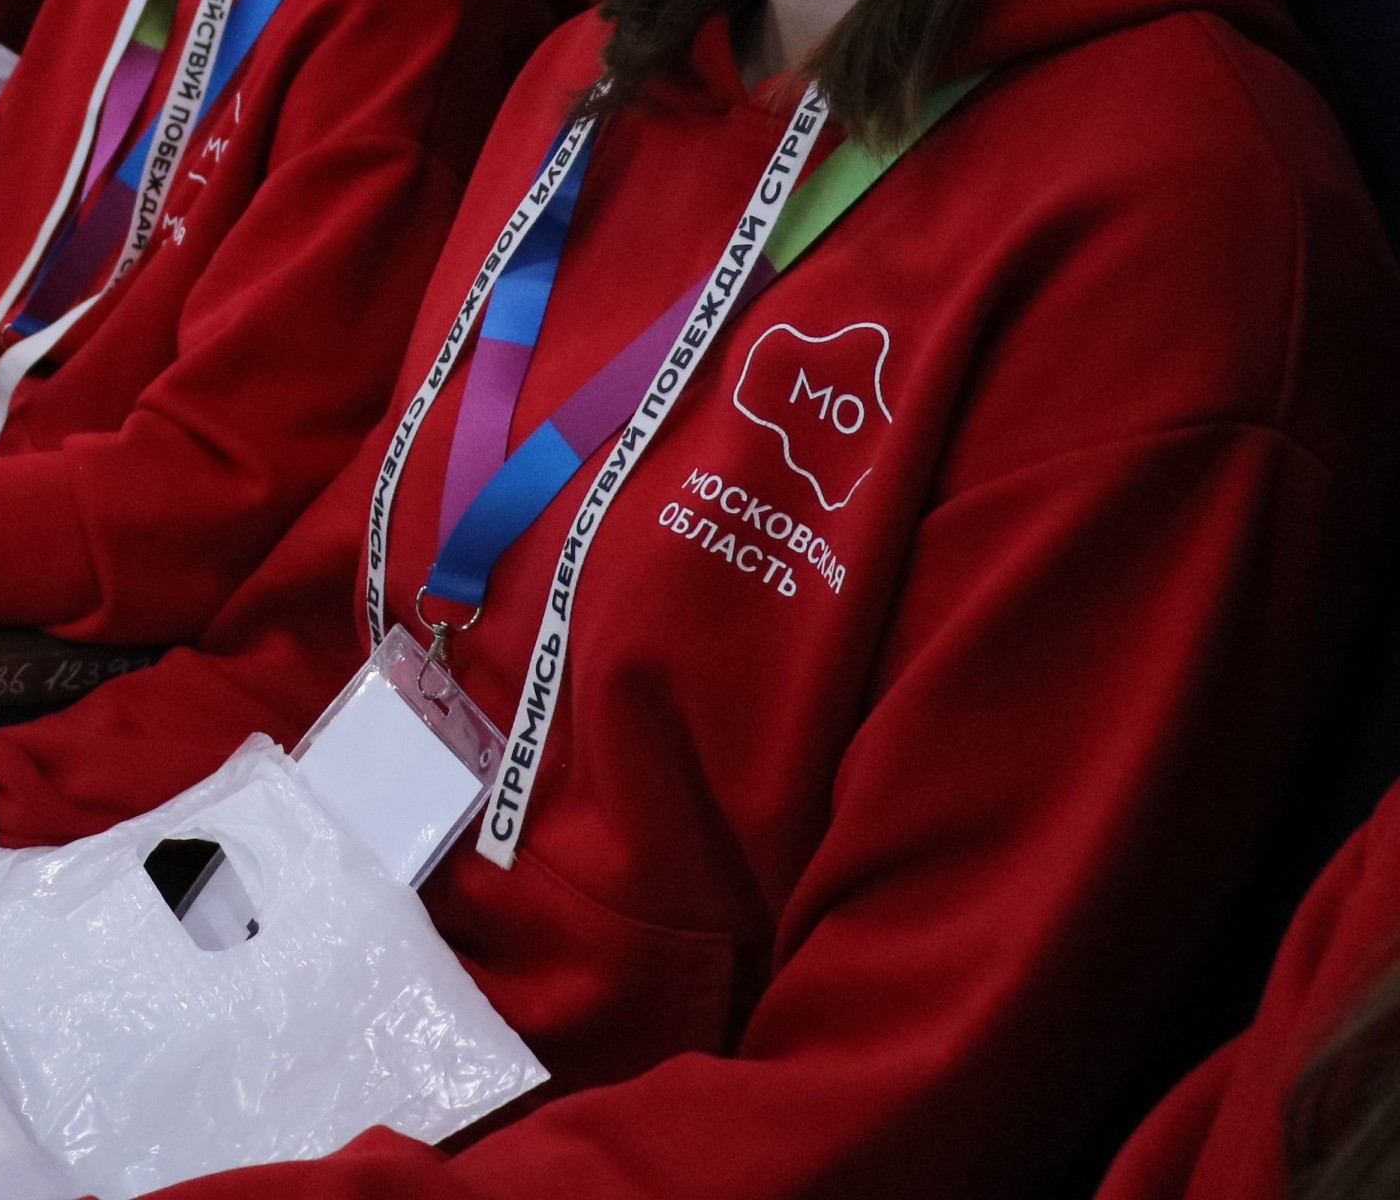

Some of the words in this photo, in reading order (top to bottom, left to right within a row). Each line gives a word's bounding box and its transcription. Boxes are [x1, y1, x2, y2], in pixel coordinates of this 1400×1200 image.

[428, 209, 529, 389] ПОБЕЖДАЙ
[789, 367, 865, 435] МО
[370, 397, 425, 570] СТРЕМИСЬ
[491, 632, 562, 841] СТРЕМИСЬ
[552, 425, 646, 622] ДЕЙСТВУЙ
[642, 214, 766, 417] ПОБЕЖДАЙ
[658, 501, 799, 598] ОБЛАСТЬ
[681, 467, 846, 595] МОСКОВСКАЯ
